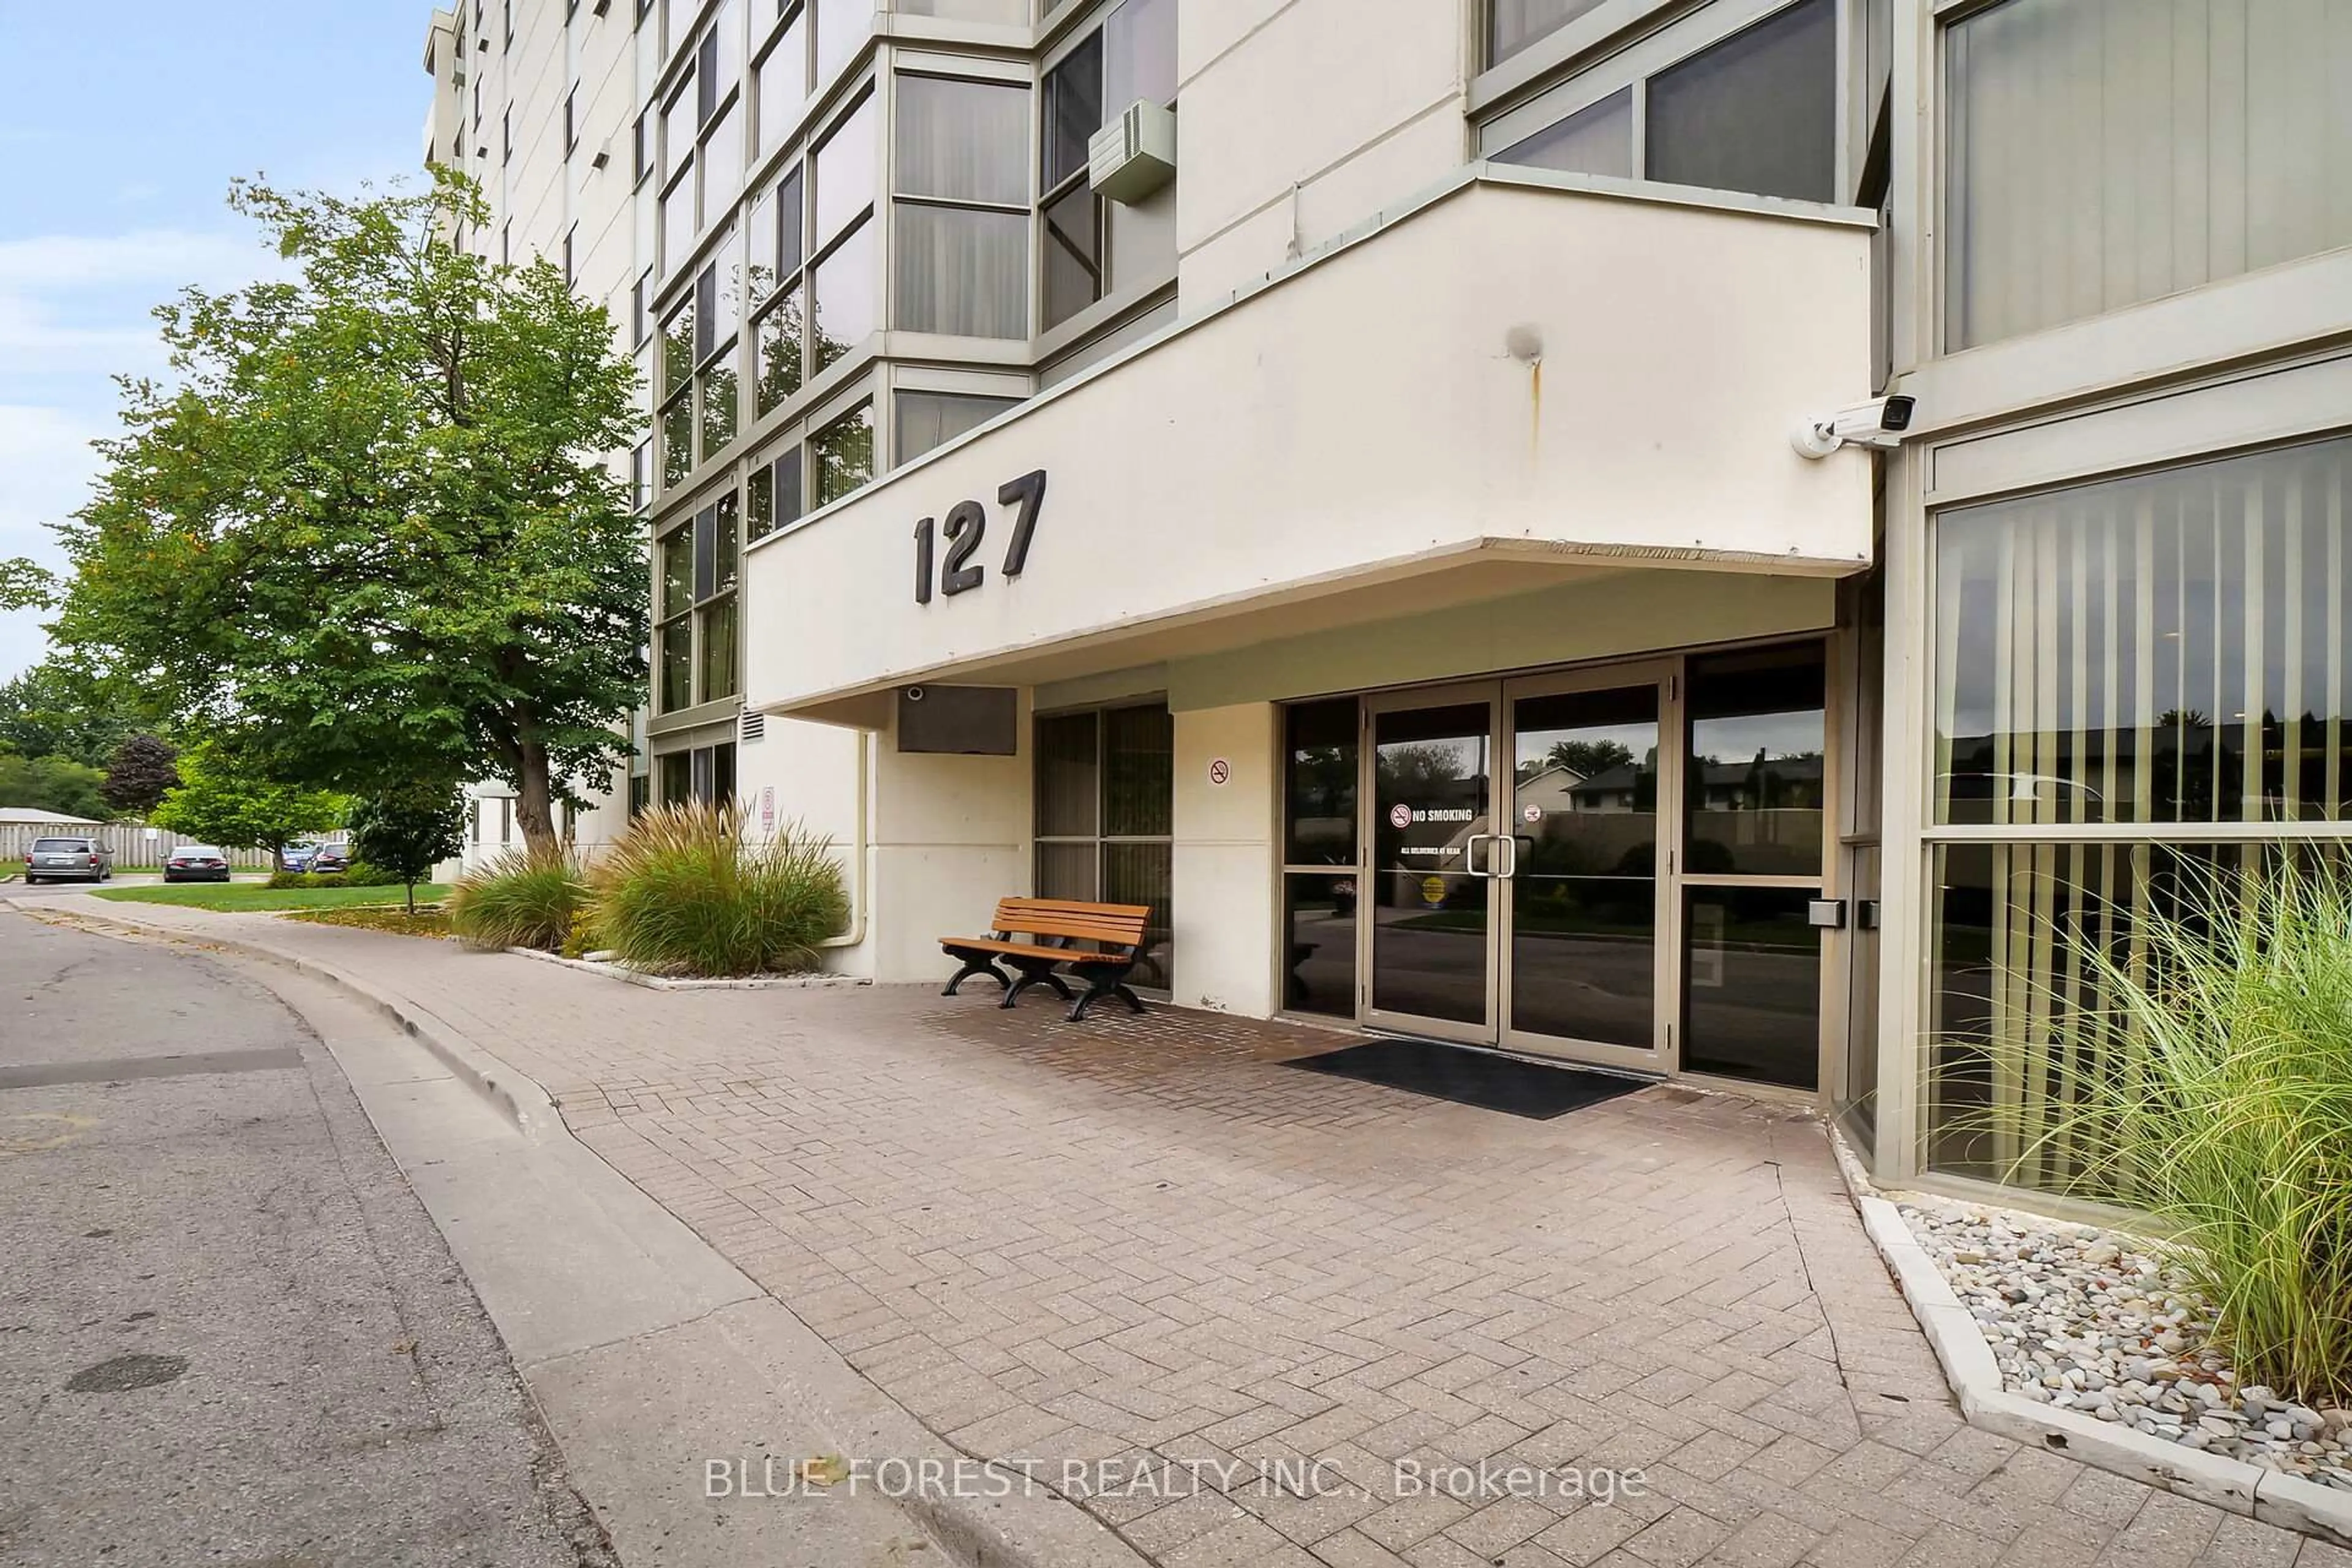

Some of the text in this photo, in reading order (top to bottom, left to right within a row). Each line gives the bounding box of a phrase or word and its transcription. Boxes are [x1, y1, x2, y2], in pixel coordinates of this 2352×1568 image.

[914, 469, 1047, 605] 127
[1412, 809, 1472, 821] NO SMOKING
